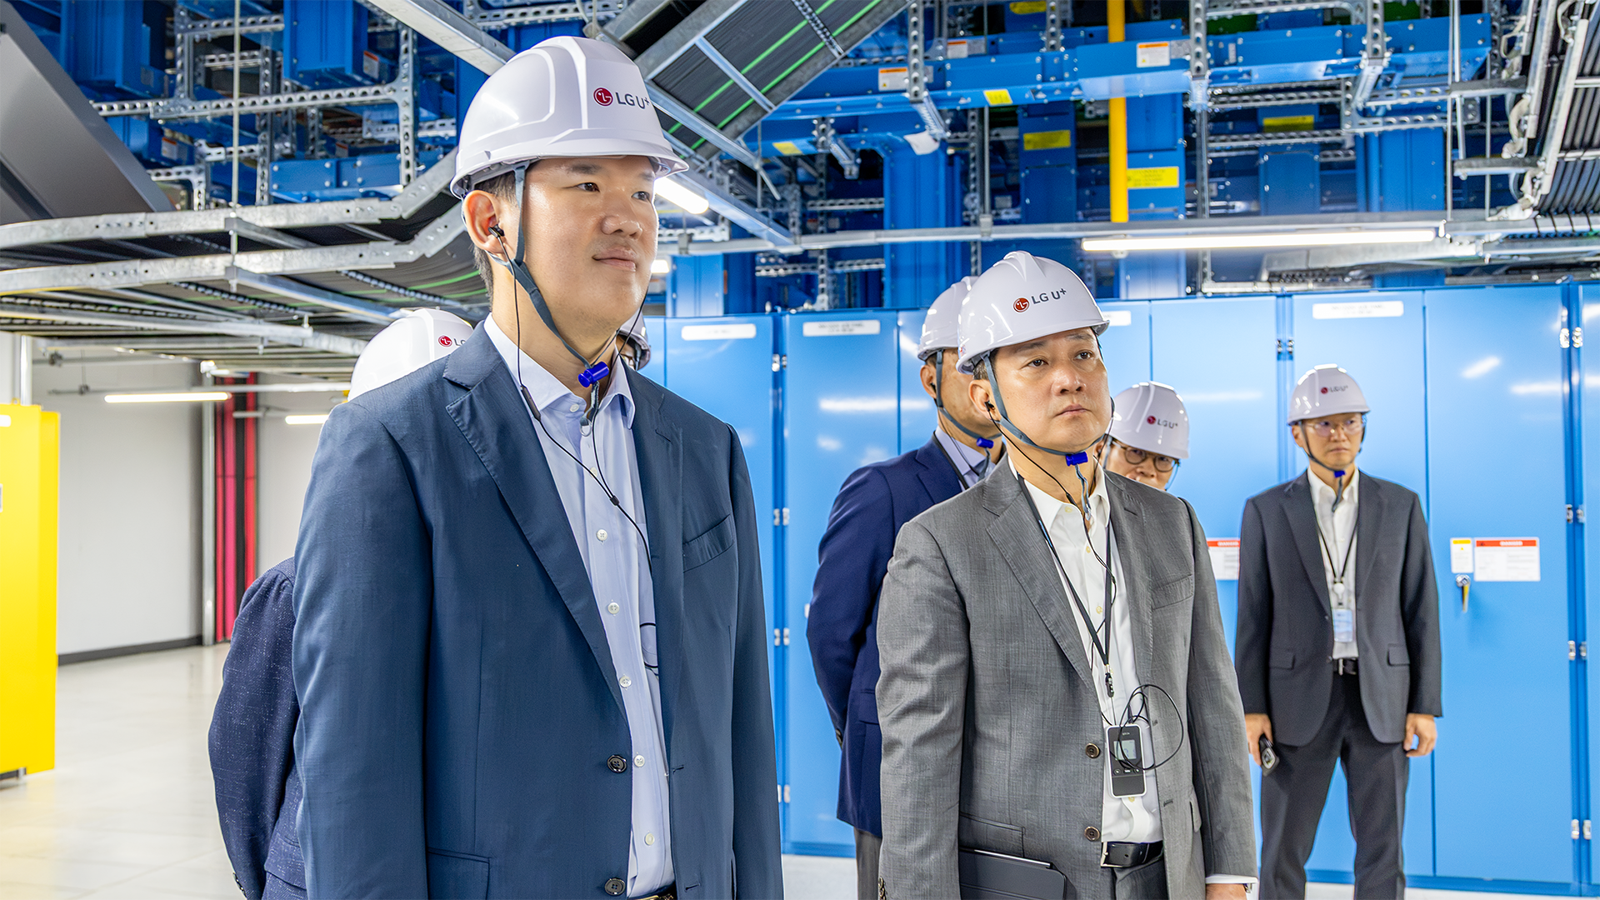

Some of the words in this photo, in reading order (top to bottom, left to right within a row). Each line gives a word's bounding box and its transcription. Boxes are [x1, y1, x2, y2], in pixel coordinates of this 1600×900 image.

[615, 91, 636, 107] LG
[1031, 292, 1049, 305] LG
[1050, 287, 1067, 300] U+
